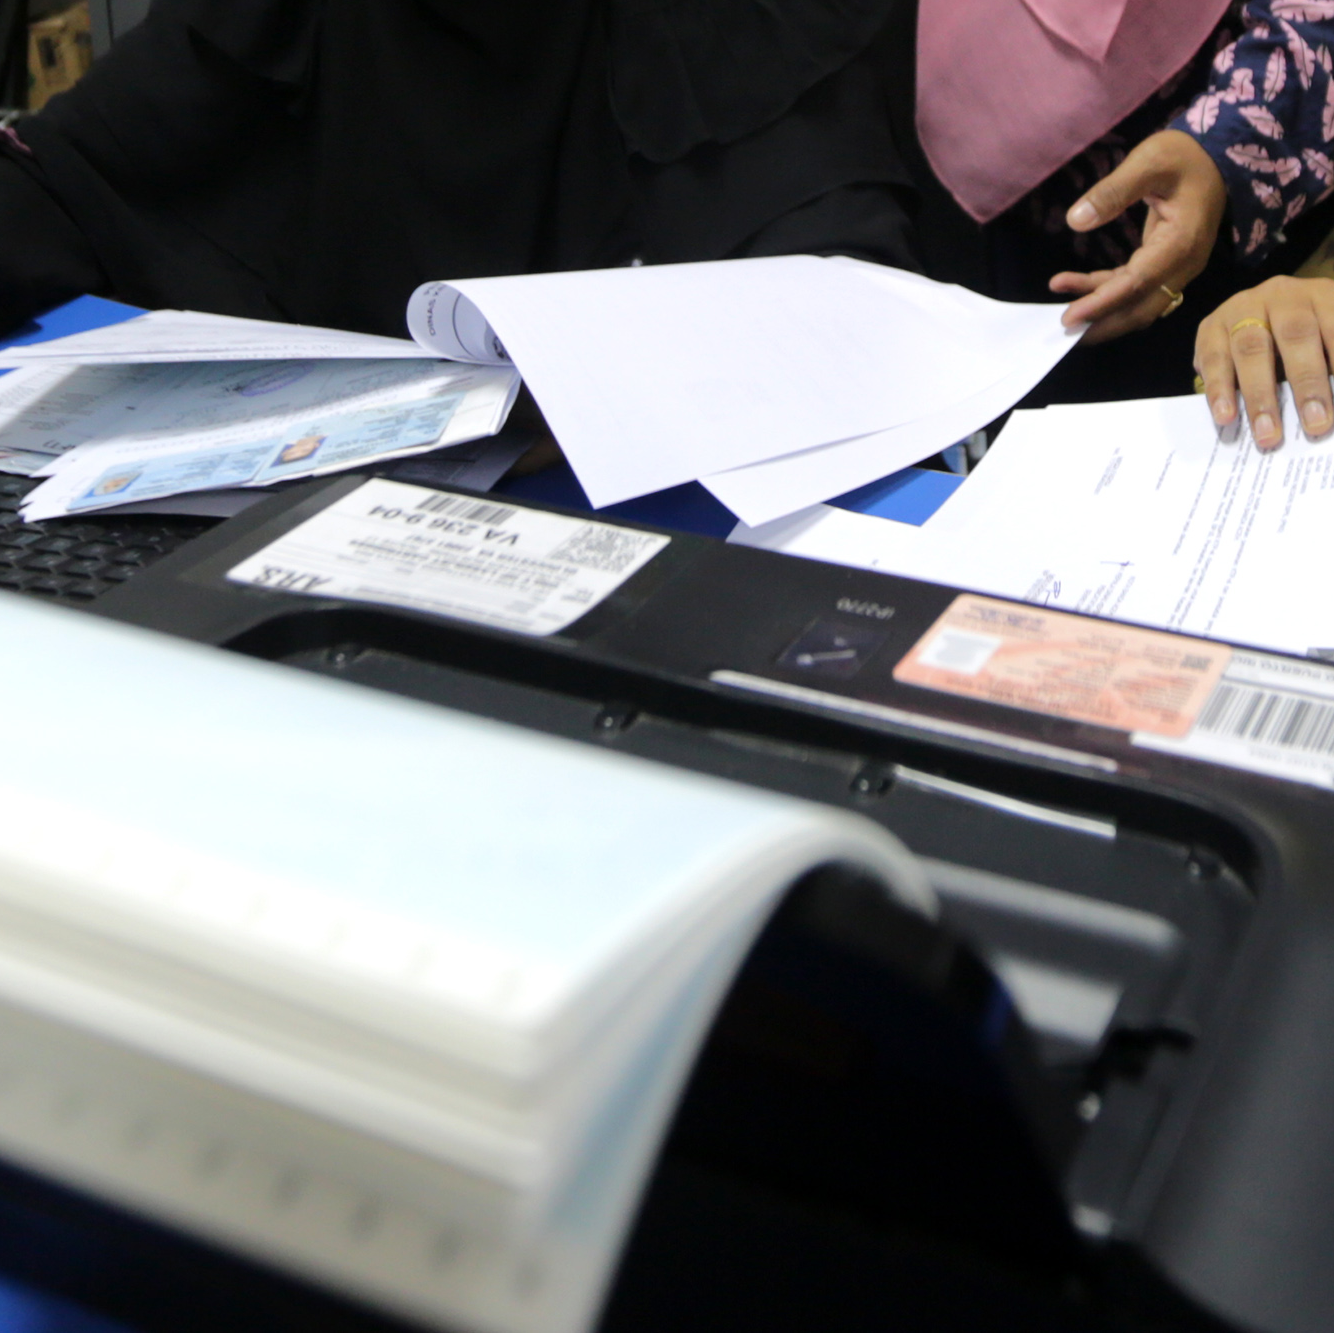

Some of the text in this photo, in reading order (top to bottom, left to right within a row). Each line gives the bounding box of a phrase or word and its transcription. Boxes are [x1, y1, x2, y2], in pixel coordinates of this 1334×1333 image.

[368, 505, 521, 546] VA 236 9-04
